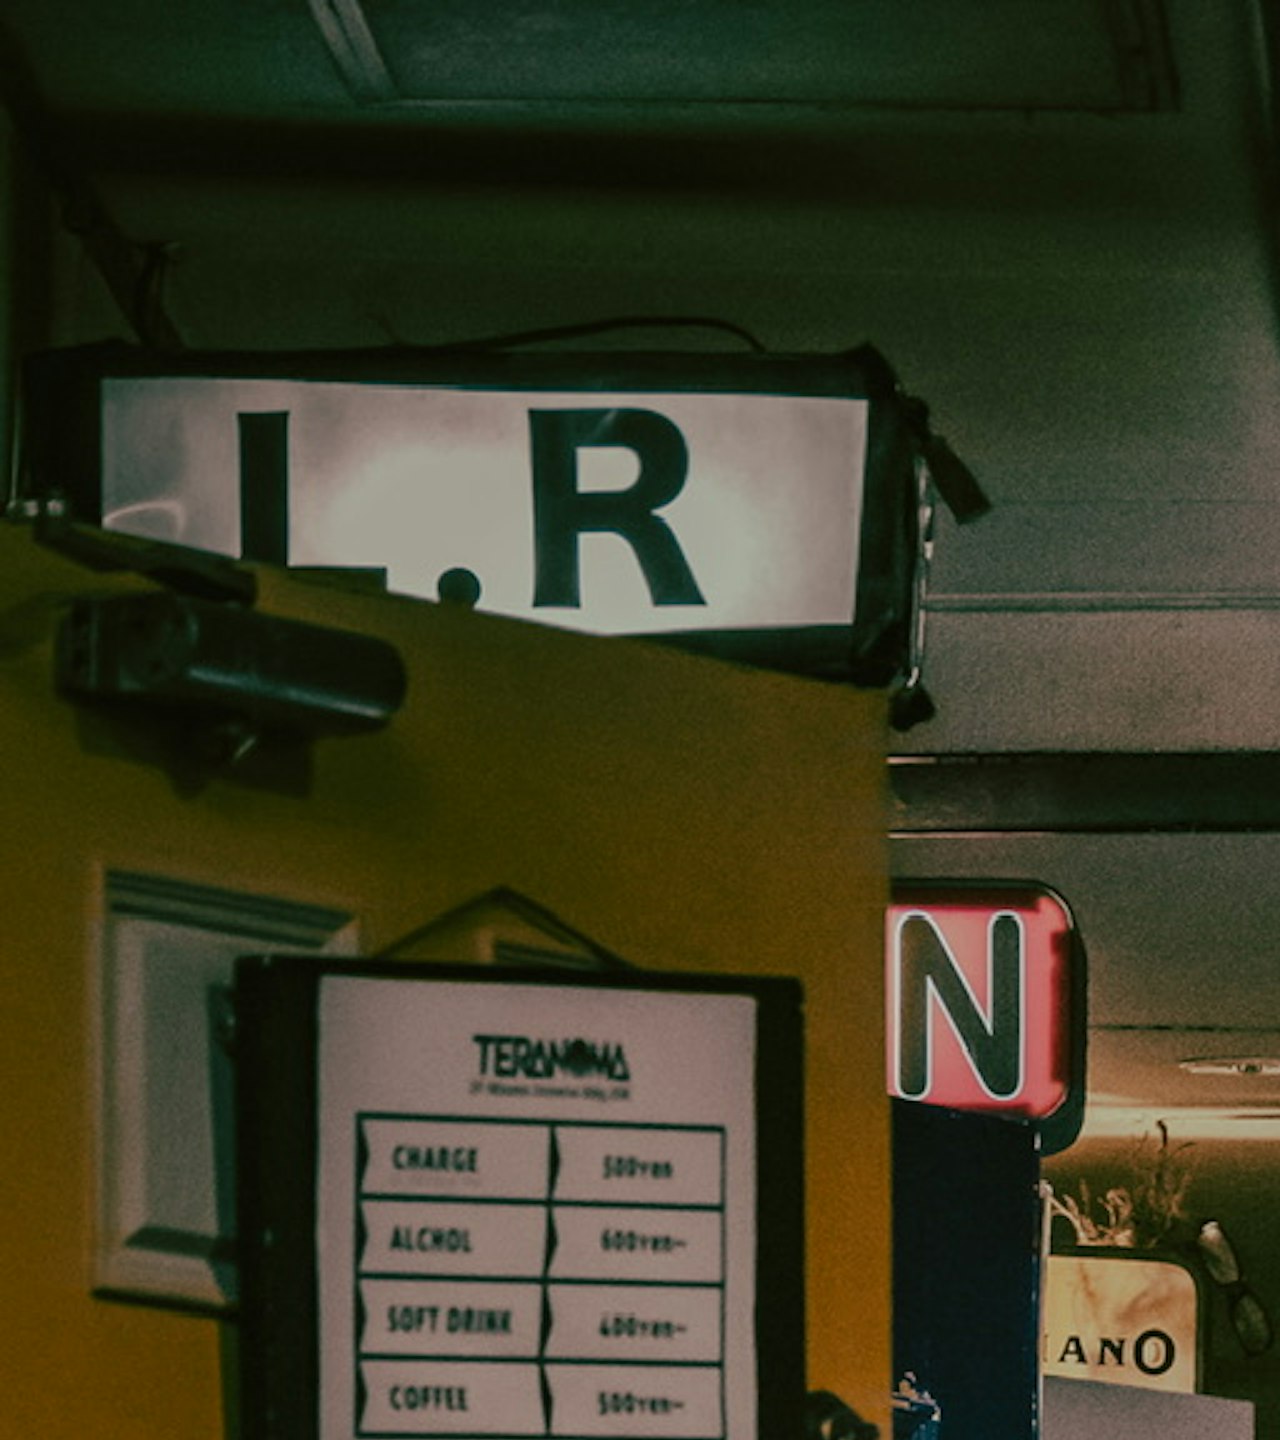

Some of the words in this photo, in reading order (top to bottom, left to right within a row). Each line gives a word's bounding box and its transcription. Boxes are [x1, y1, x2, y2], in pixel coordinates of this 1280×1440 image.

[392, 1145, 479, 1173] CHARGE
[387, 1306, 441, 1333] SOFT
[447, 1307, 511, 1334] DRINK
[1043, 1329, 1175, 1375] ANO
[390, 1386, 468, 1412] COFFEE
